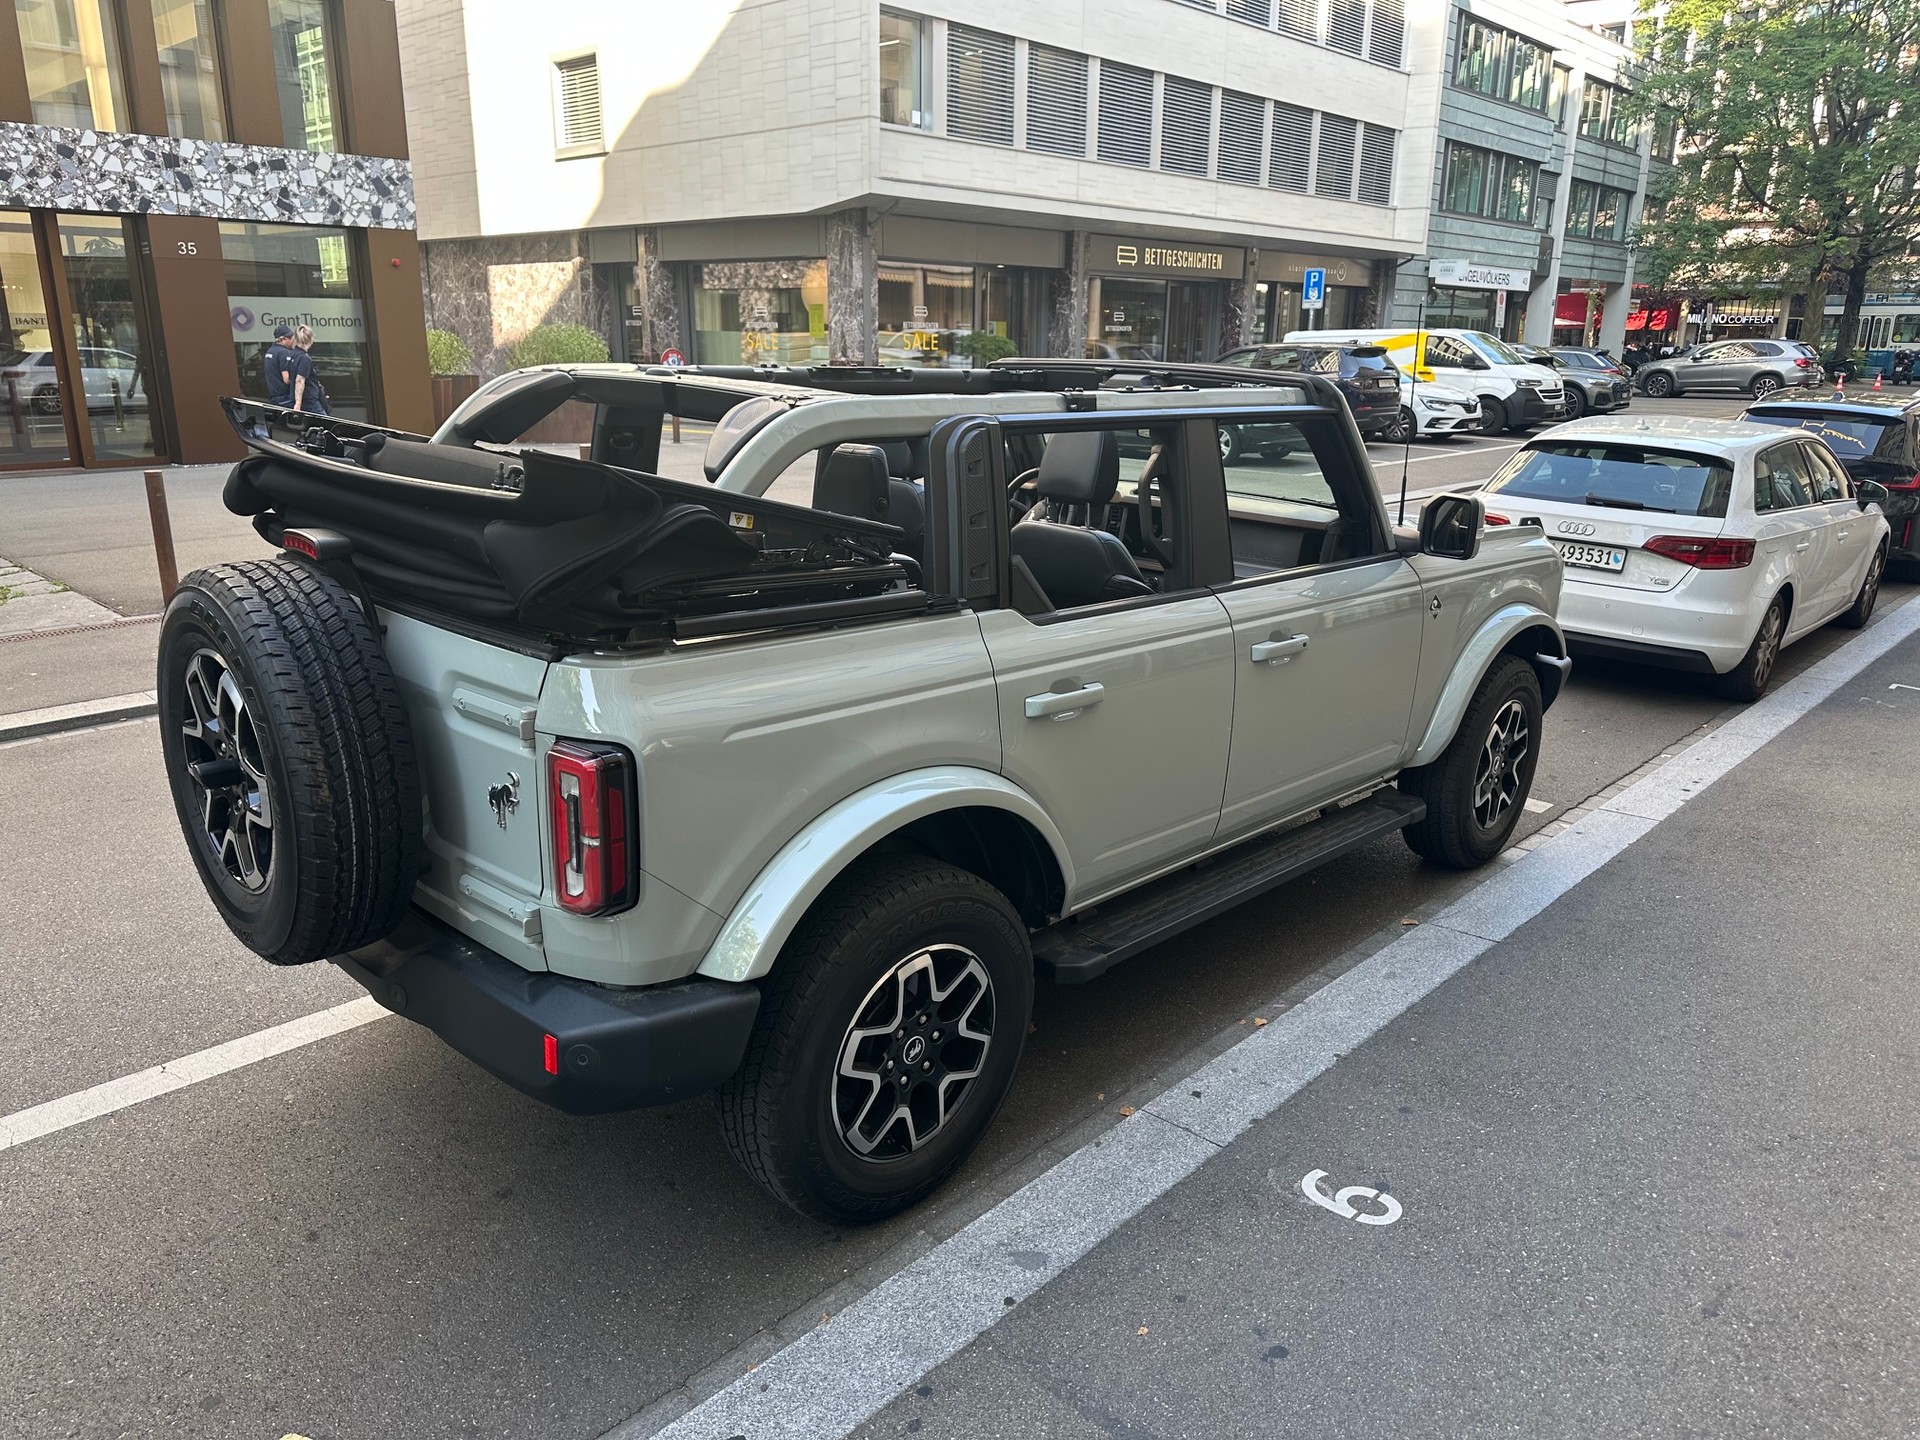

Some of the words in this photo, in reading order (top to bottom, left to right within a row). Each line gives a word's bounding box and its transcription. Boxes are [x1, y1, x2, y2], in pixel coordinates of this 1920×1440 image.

[177, 241, 197, 255] 35
[1144, 247, 1223, 270] BETTGESCHICHTEN
[1310, 272, 1320, 287] P
[14, 317, 46, 325] BANT
[261, 312, 300, 326] Grant
[301, 313, 362, 328] Thornton
[1686, 313, 1727, 324] MILNO
[1727, 315, 1775, 324] COIFFEUR
[746, 332, 779, 350] SALE
[903, 333, 939, 351] SALE
[1560, 544, 1613, 566] 493531
[864, 900, 1027, 968] BRIDGESTONE
[1301, 1168, 1403, 1226] 6
